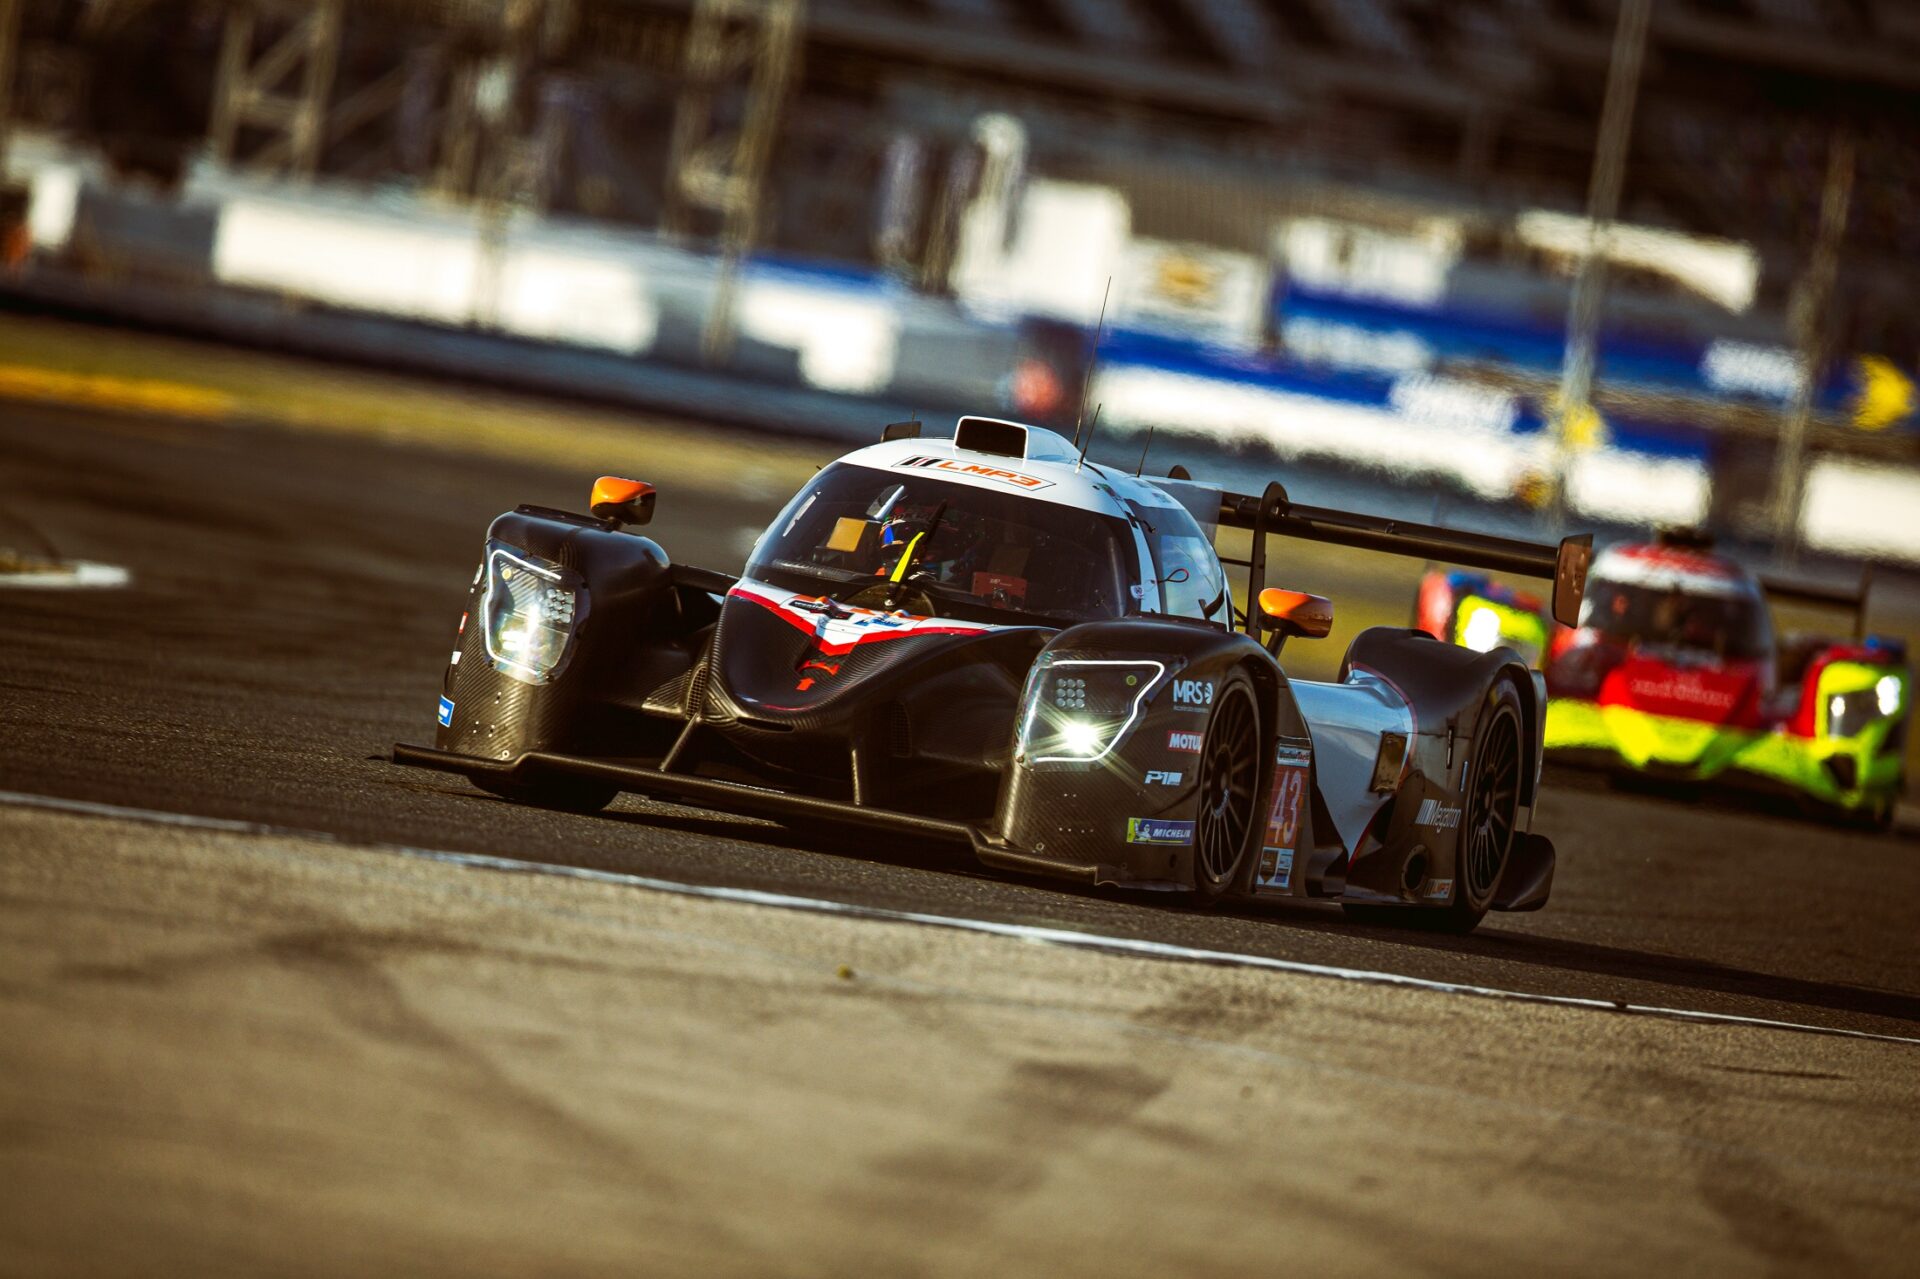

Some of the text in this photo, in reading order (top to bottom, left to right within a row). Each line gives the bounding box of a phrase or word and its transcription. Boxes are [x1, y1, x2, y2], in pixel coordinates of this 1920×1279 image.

[937, 461, 1042, 487] LMP3
[1173, 679, 1204, 705] MRS
[1269, 770, 1302, 844] 43
[1152, 828, 1192, 838] MICHELIN
